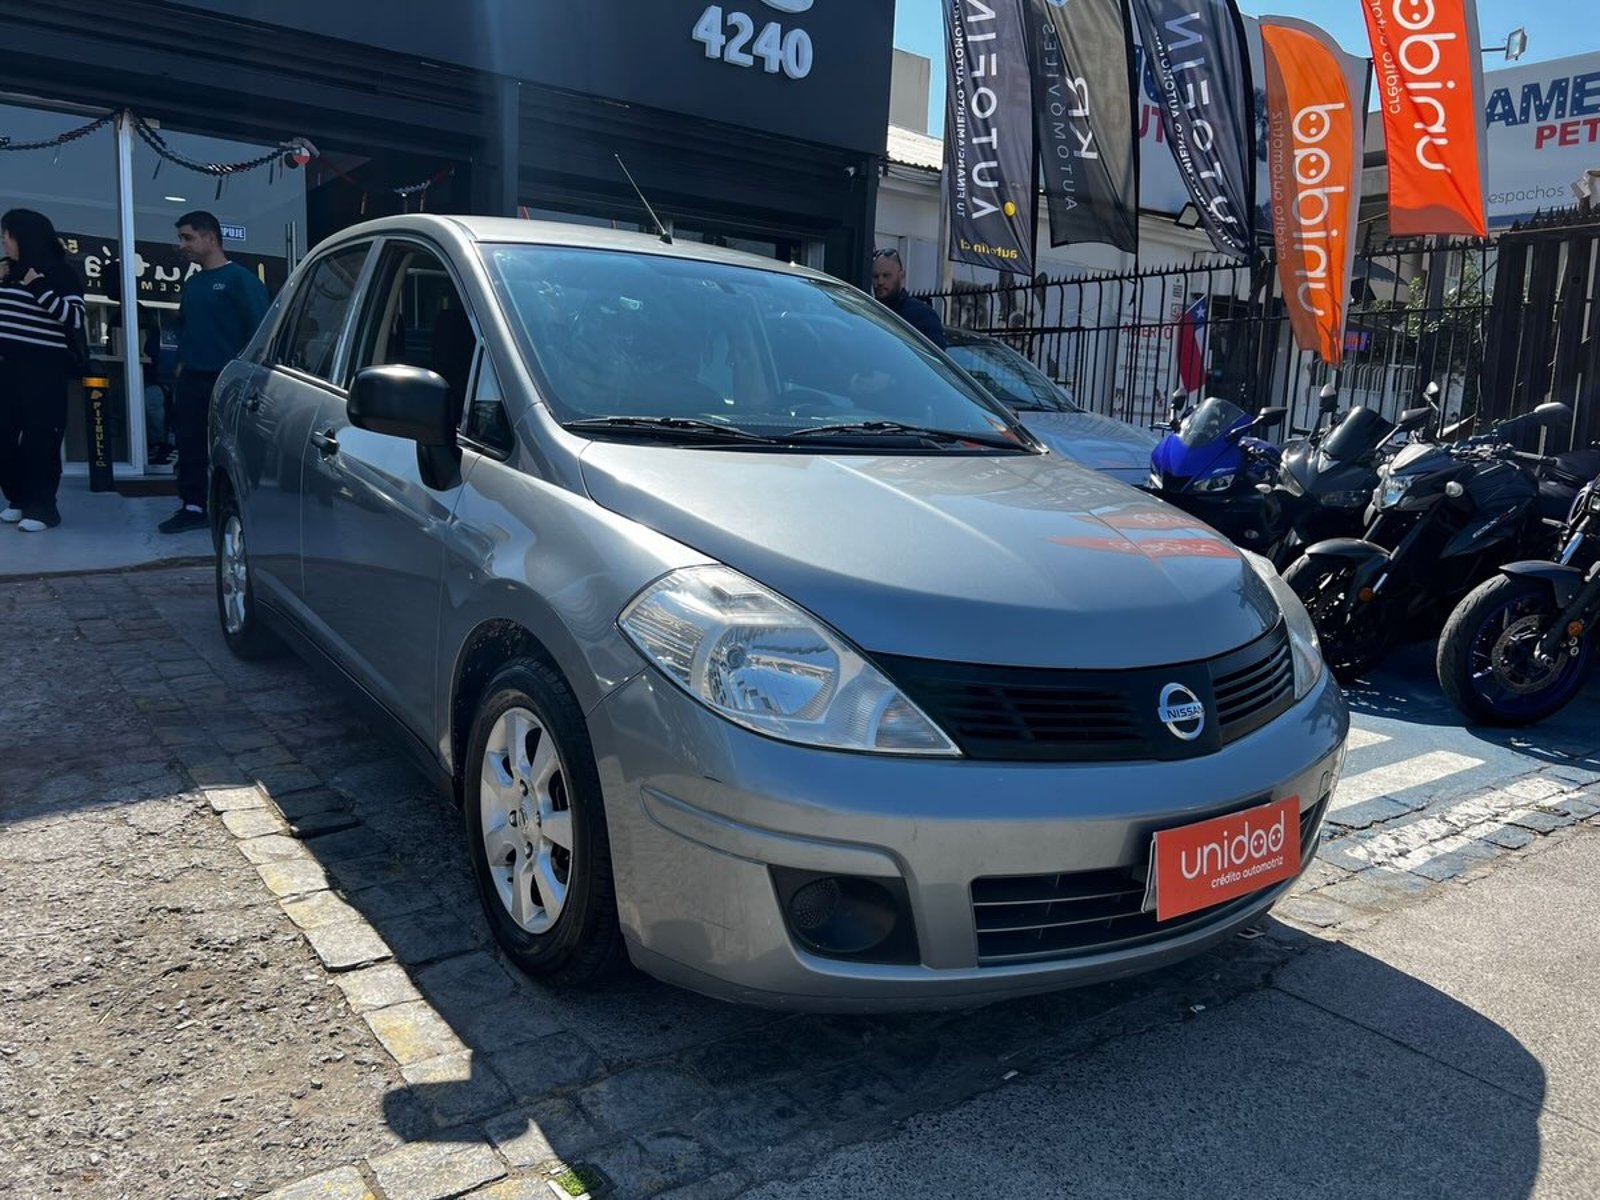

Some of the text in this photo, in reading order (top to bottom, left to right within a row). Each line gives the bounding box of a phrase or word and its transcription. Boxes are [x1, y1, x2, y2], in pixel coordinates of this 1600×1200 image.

[692, 5, 813, 79] 4240
[1485, 71, 1600, 130] AME
[1535, 117, 1600, 149] PET
[1167, 703, 1204, 719] NISSAN
[1181, 810, 1285, 879] unidad
[1211, 856, 1284, 888] crédito automotriz
